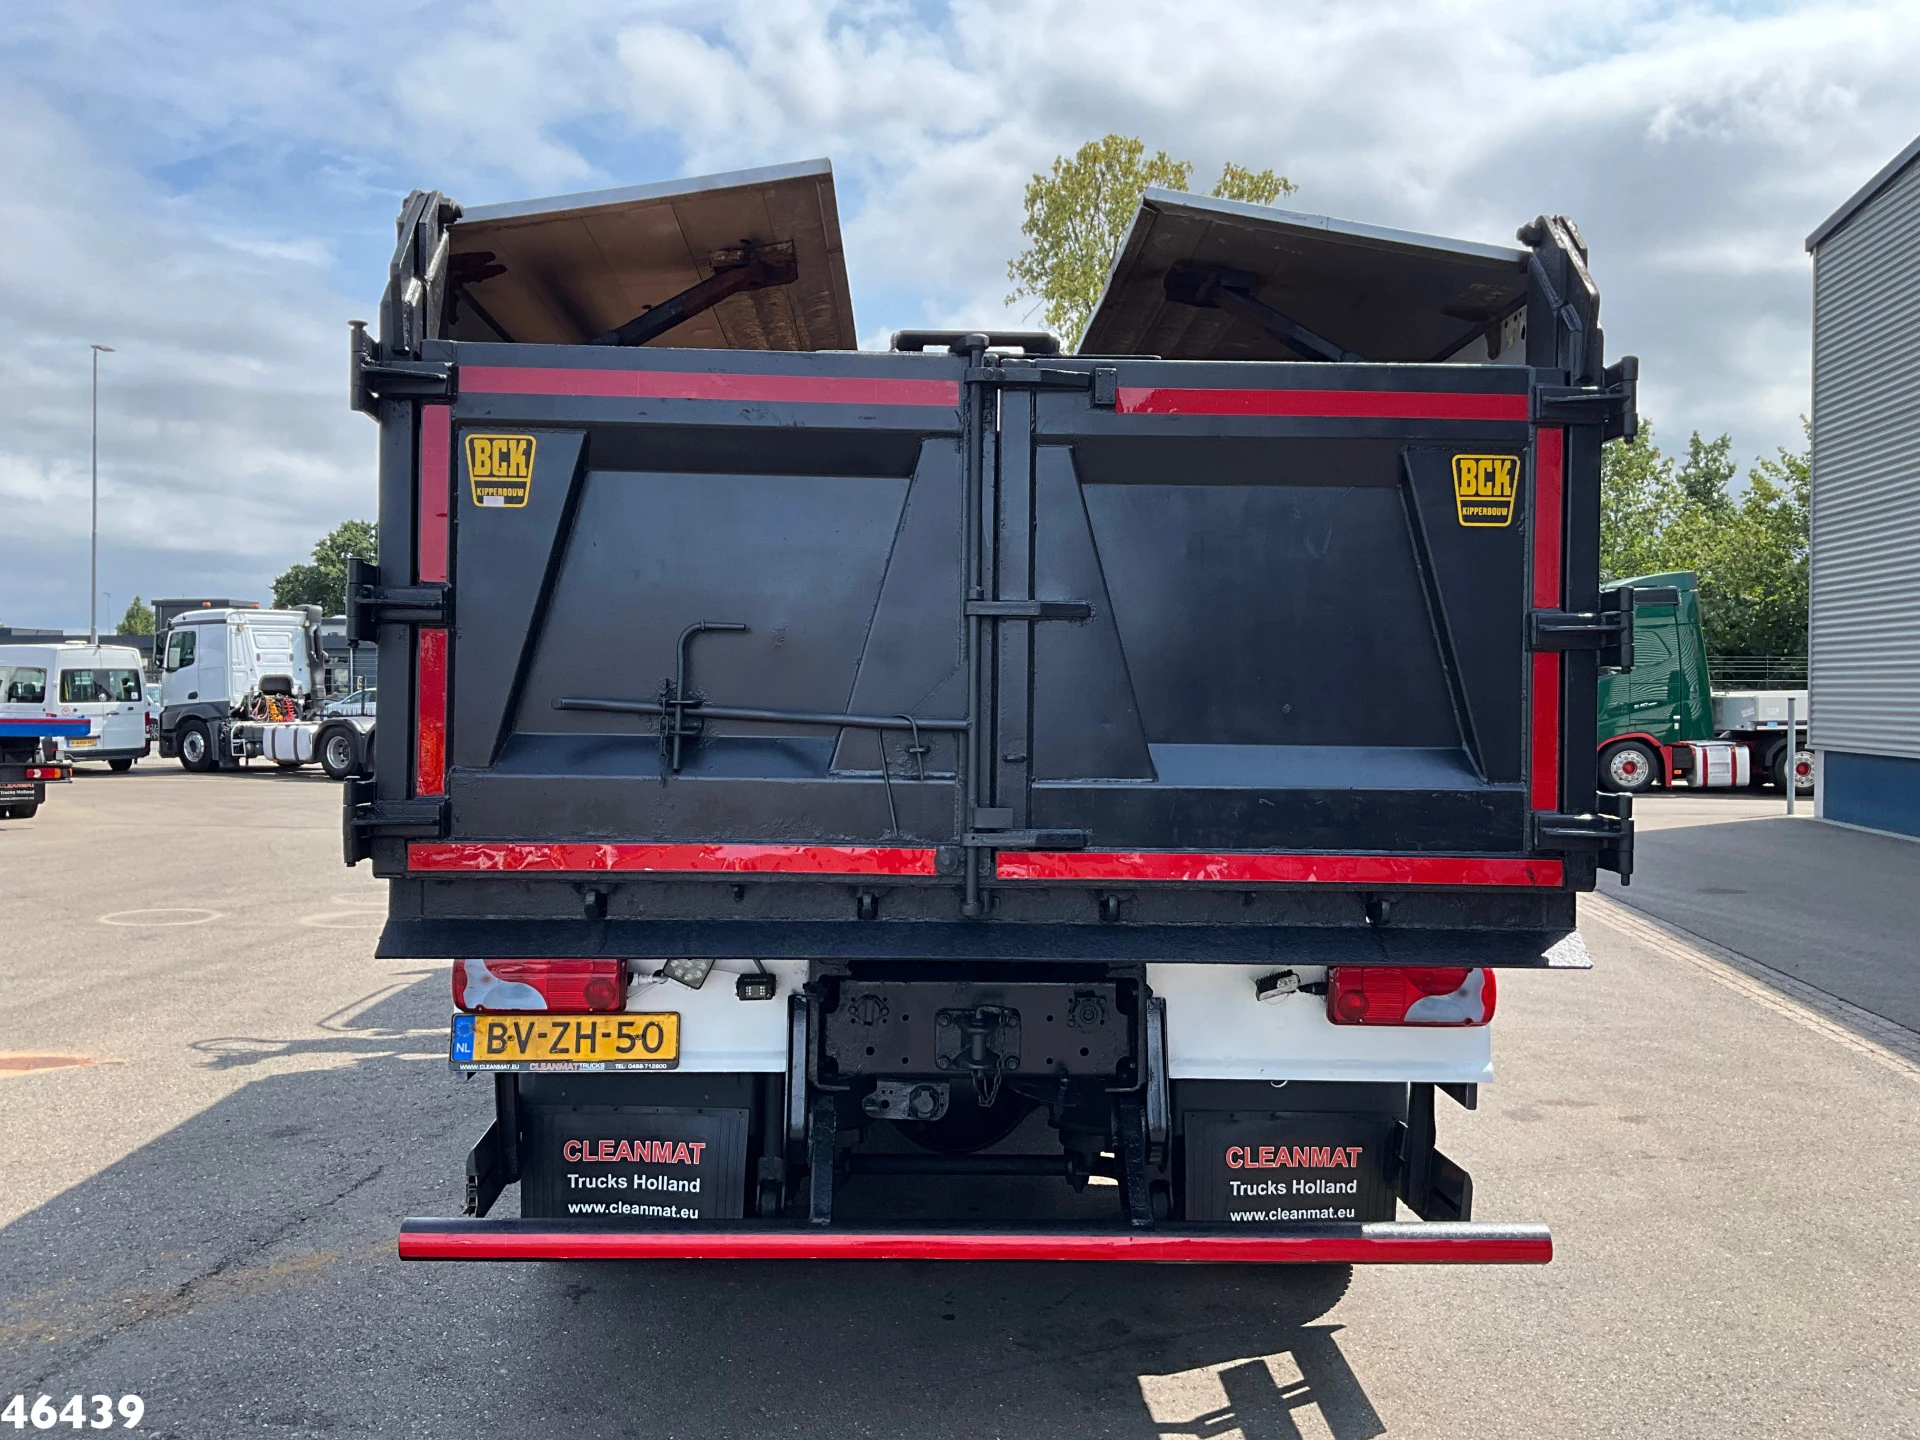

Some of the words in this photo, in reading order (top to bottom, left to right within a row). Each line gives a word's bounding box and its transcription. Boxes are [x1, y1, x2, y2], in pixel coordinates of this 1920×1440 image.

[473, 438, 527, 477] BCK
[1459, 459, 1511, 496] BCK
[476, 487, 525, 497] KIPPERBOUW
[1462, 506, 1508, 516] KIPPERBOUW
[486, 1021, 664, 1054] BV-ZH-50
[456, 1042, 471, 1053] NL
[563, 1140, 706, 1165] CLEANMAT
[1225, 1146, 1363, 1169] CLEANMAT
[567, 1174, 628, 1189] Trucks
[633, 1174, 701, 1193] Holland
[1229, 1180, 1287, 1196] Trucks
[1292, 1179, 1358, 1195] Holland
[567, 1201, 699, 1220] www.cleanmat.eu
[1229, 1207, 1356, 1222] www.cleanmat.eu
